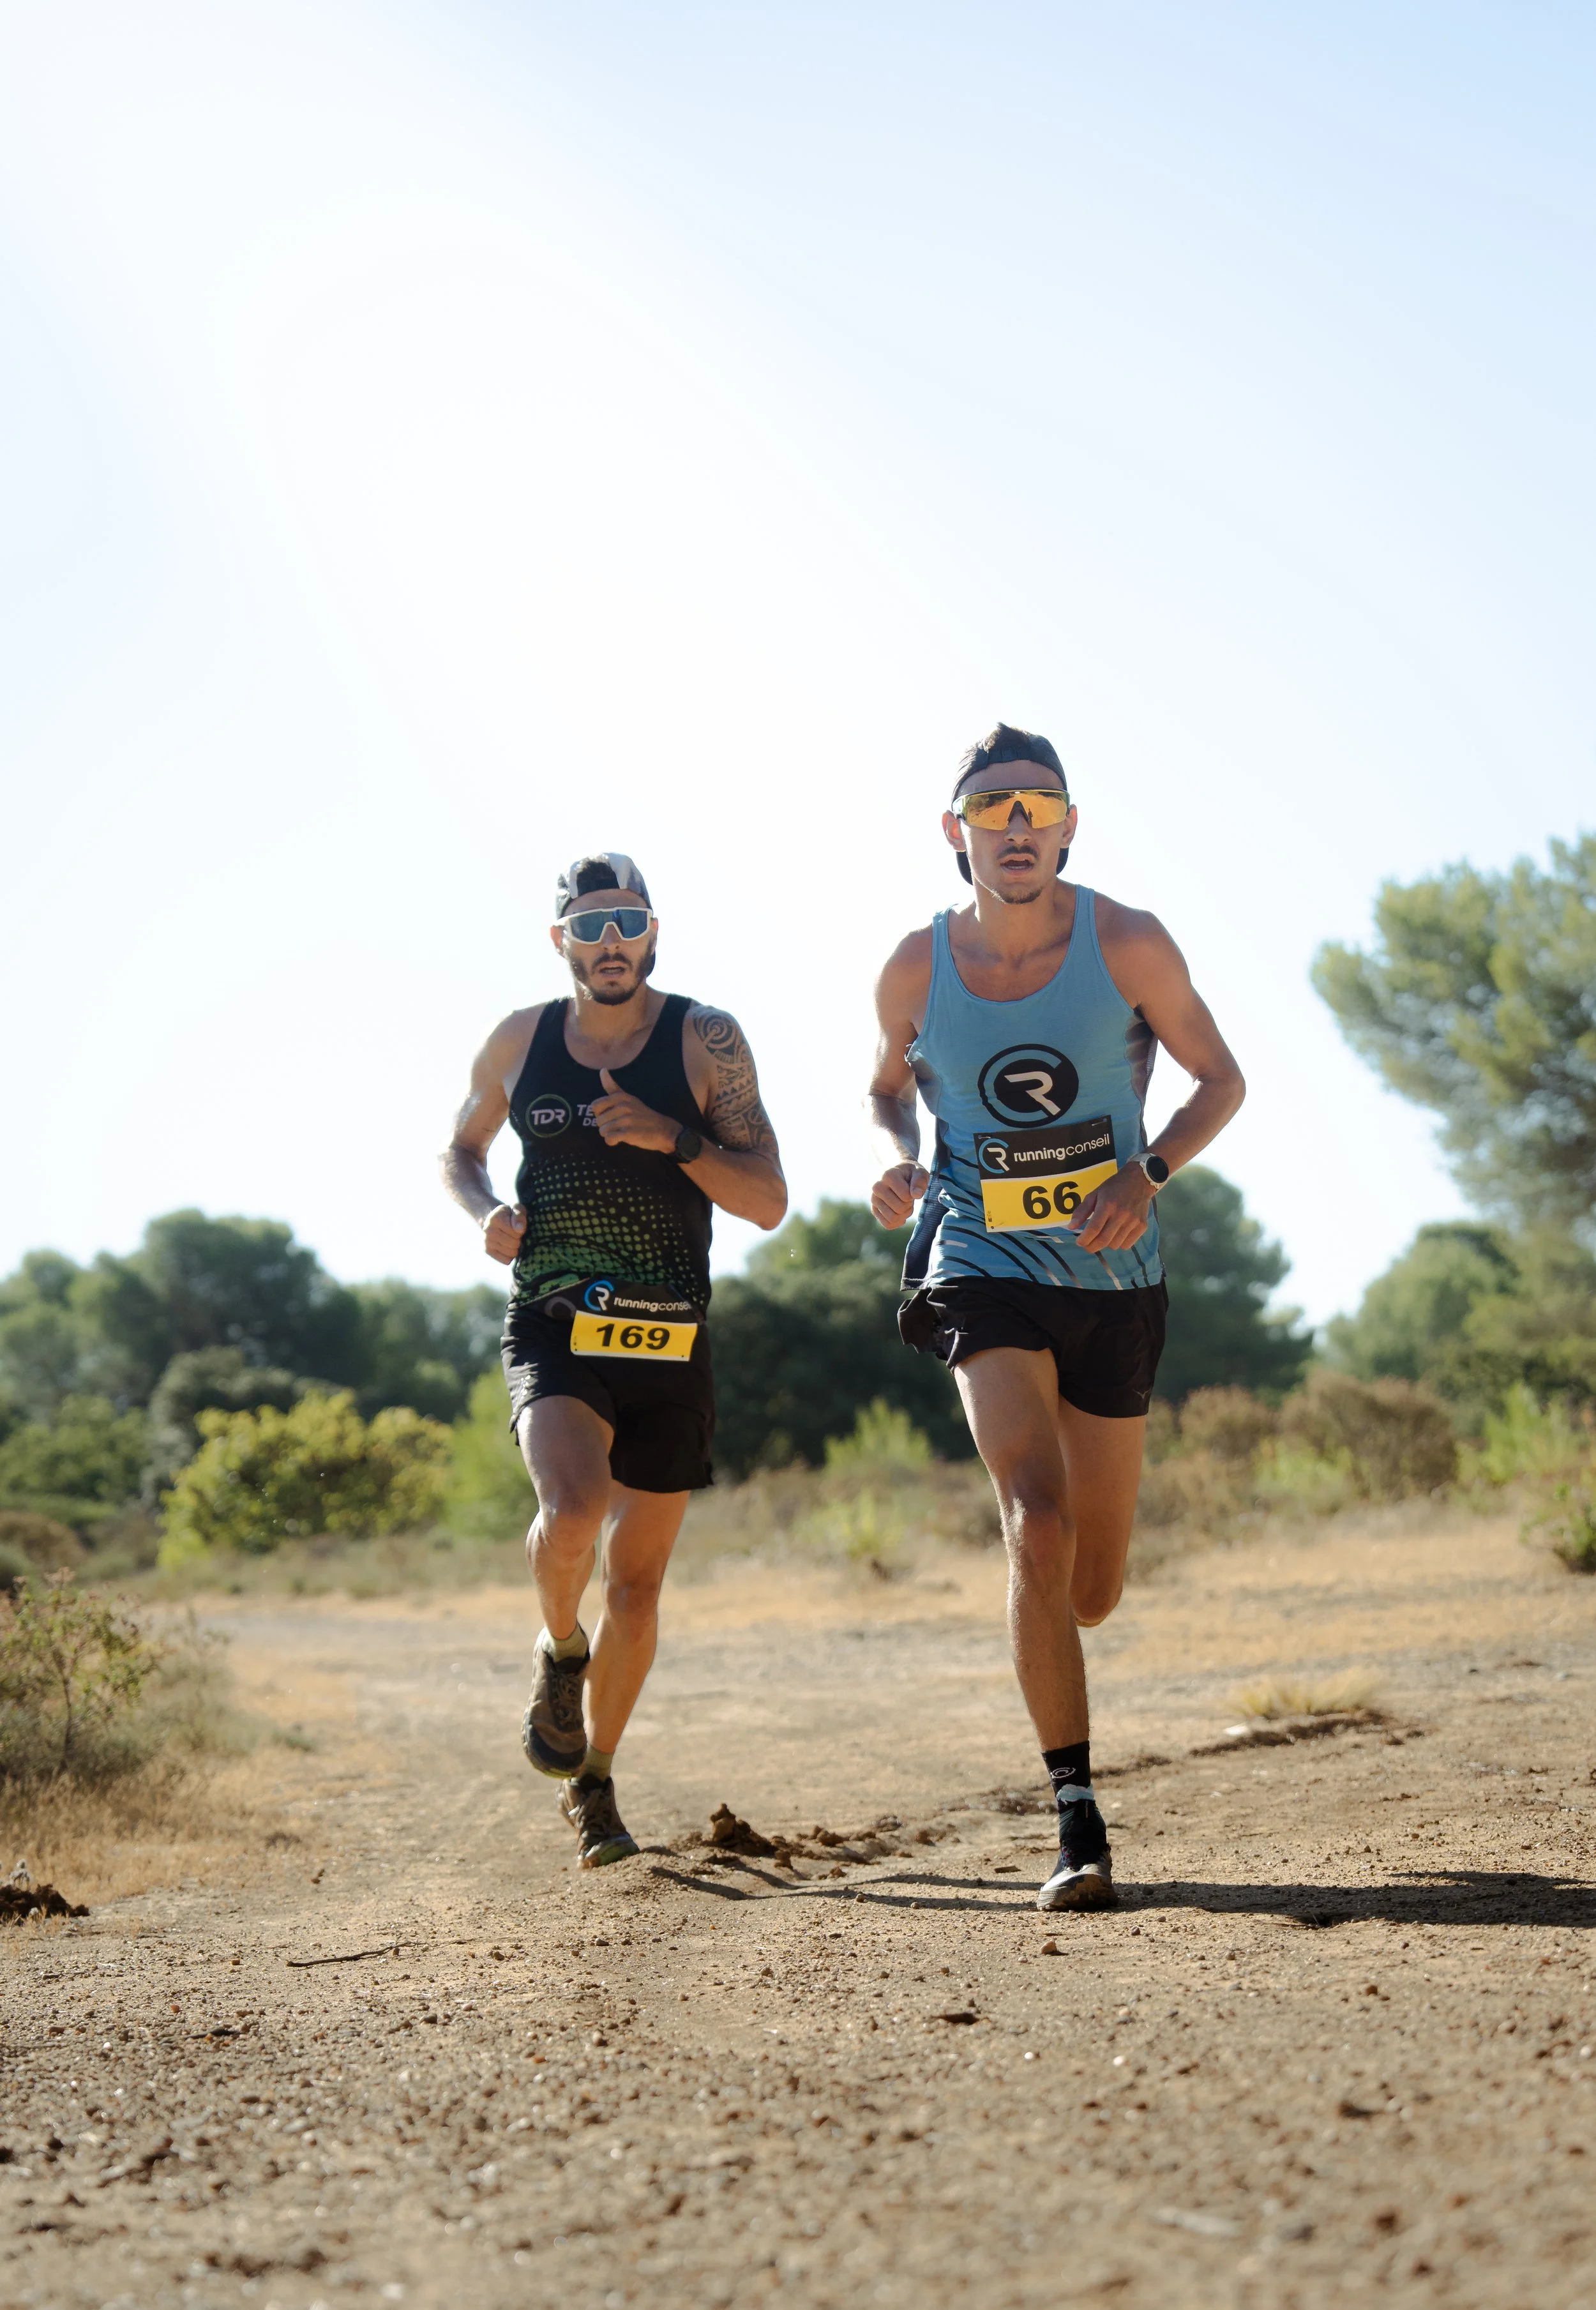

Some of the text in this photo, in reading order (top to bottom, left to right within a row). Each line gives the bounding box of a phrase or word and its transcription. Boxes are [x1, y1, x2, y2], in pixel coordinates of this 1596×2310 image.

[531, 1108, 566, 1125] TDR
[1013, 1133, 1110, 1162] runningconseil
[1022, 1181, 1081, 1219] 66
[614, 1297, 691, 1312] runningconse
[596, 1324, 670, 1350] 169
